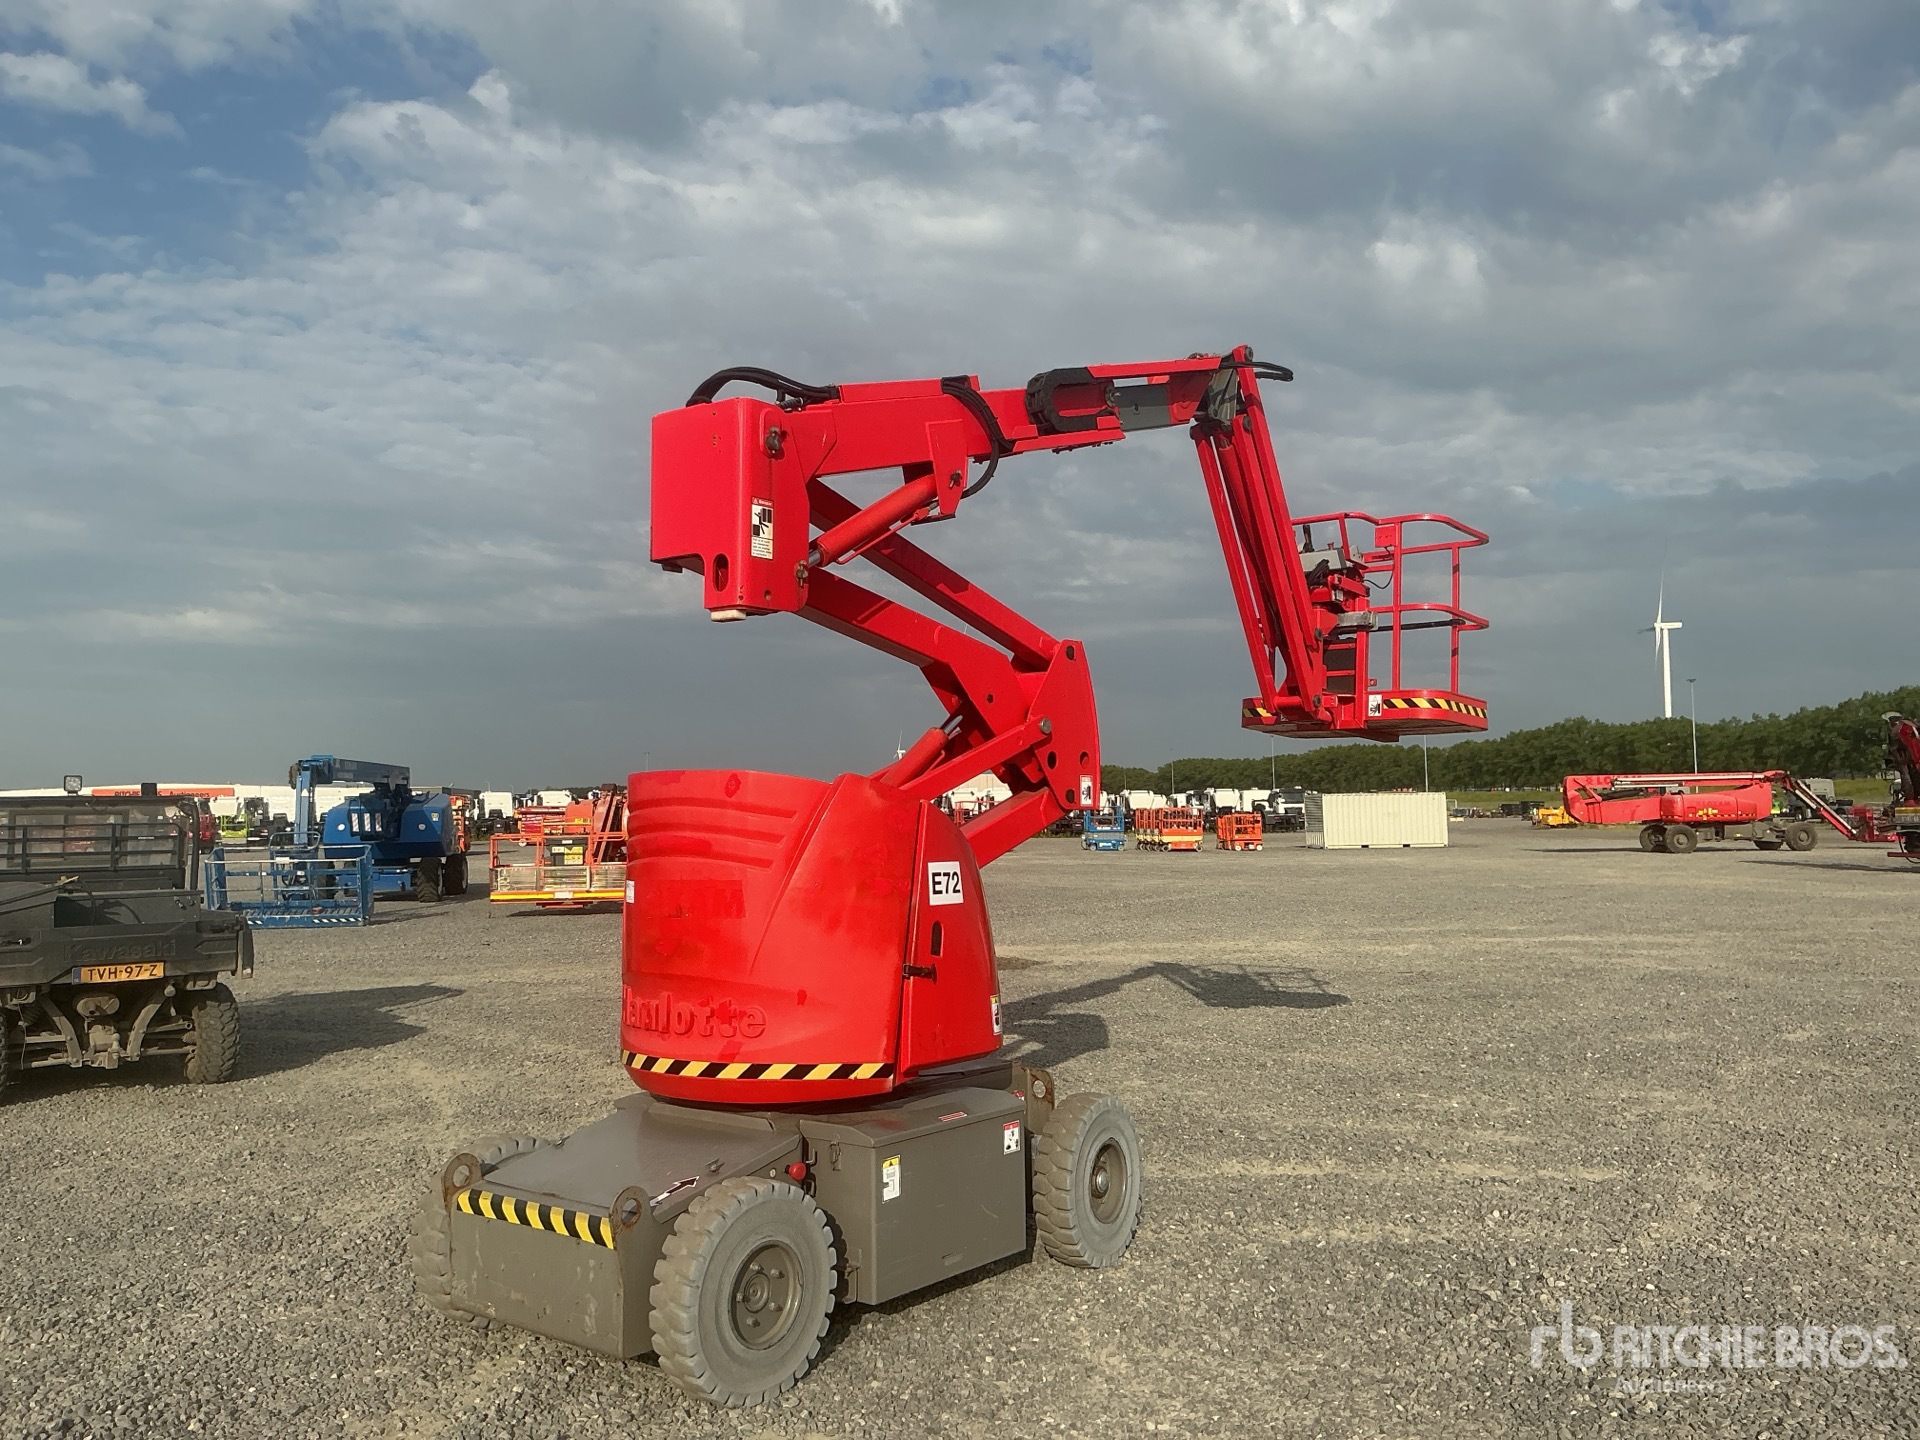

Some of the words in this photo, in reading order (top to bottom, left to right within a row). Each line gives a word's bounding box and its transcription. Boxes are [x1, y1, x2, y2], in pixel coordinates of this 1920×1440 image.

[931, 871, 961, 895] E72
[63, 939, 176, 963] Kawasaki
[87, 964, 158, 981] TVH-97-Z
